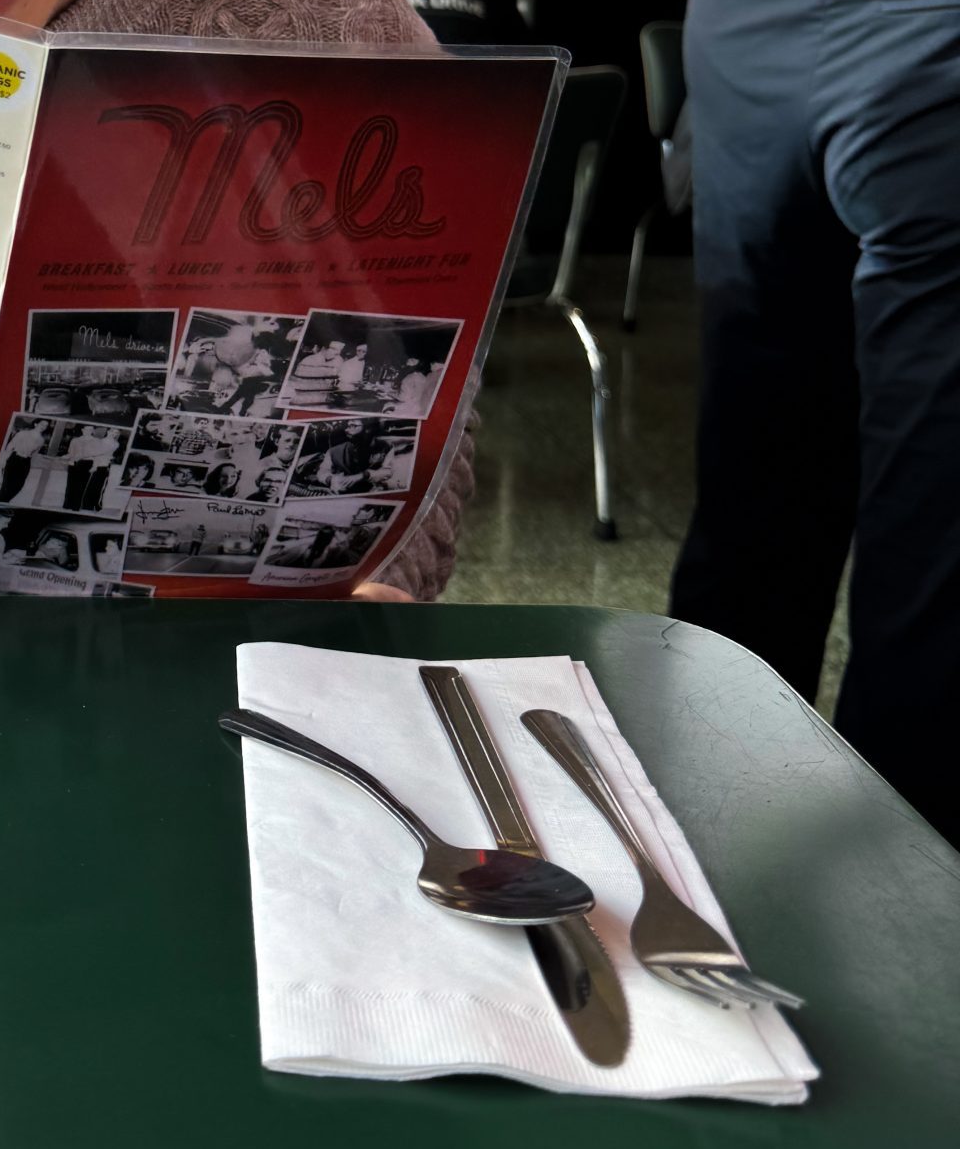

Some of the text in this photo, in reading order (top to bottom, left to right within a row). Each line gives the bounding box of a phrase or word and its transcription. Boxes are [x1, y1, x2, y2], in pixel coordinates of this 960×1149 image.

[97, 100, 446, 246] Mels
[37, 263, 135, 277] BREAKFAST
[168, 262, 224, 276] LUNCH
[78, 325, 119, 349] Mels
[46, 571, 87, 591] Opening
